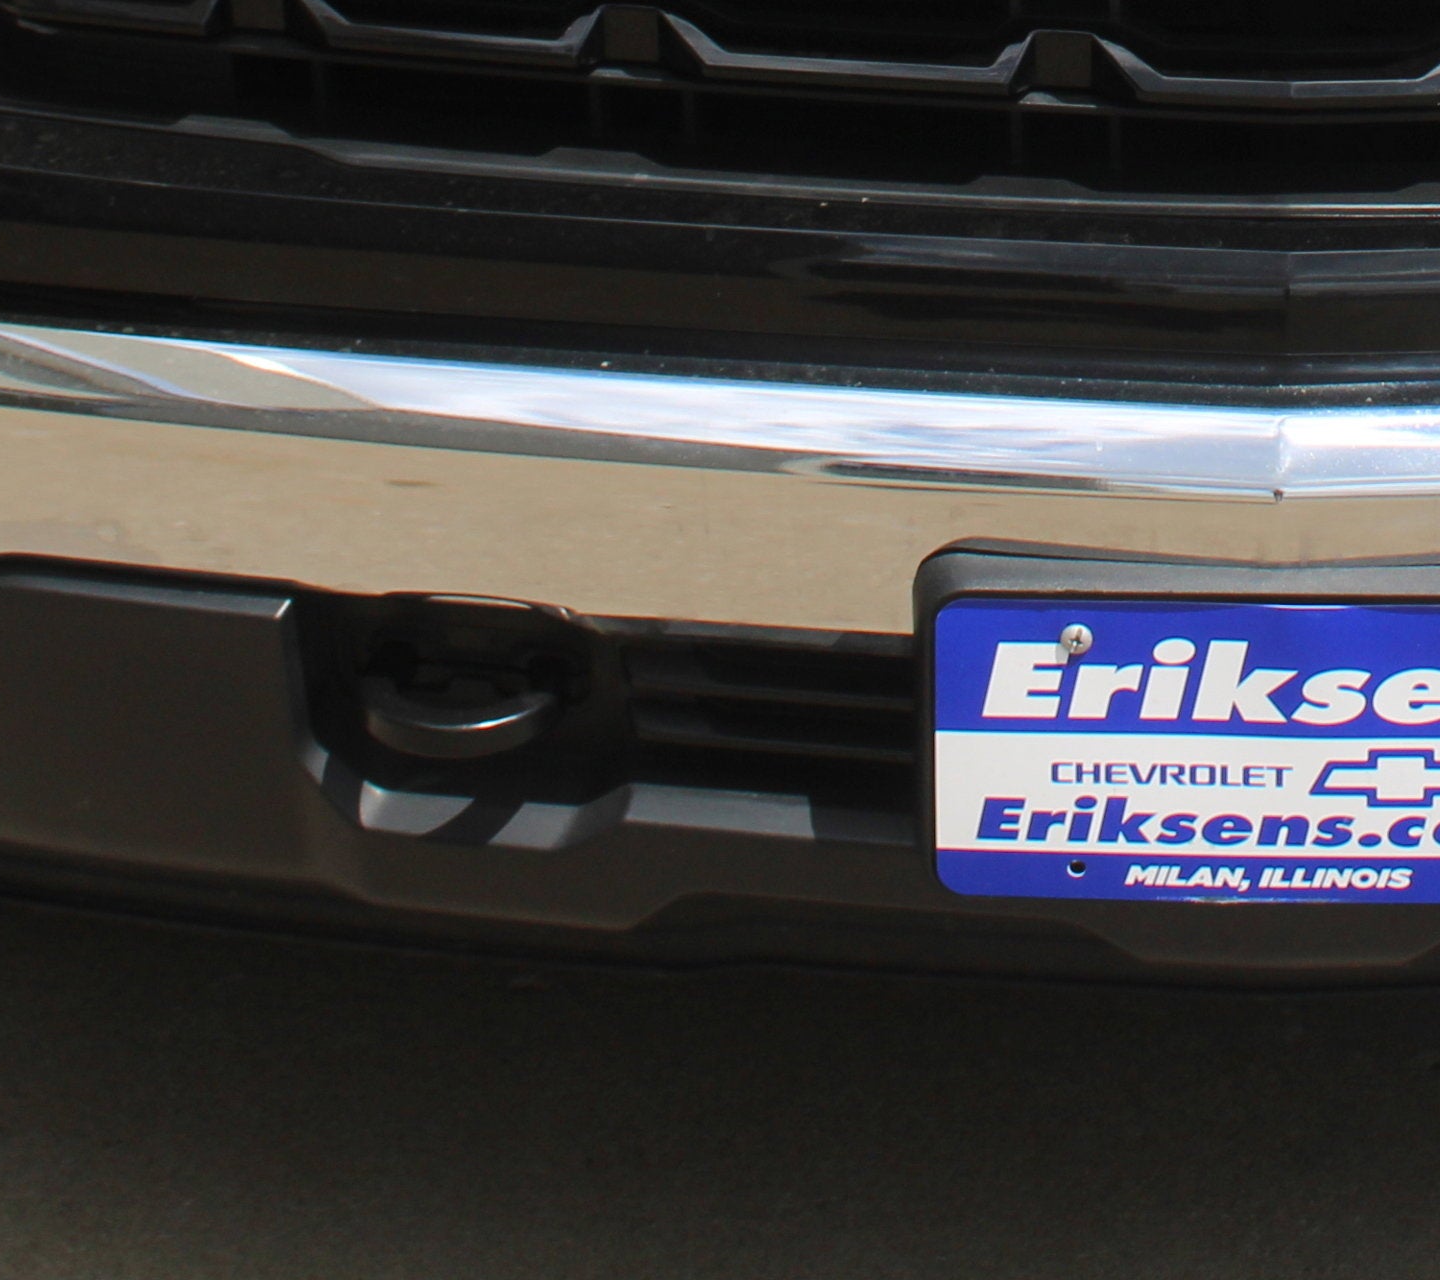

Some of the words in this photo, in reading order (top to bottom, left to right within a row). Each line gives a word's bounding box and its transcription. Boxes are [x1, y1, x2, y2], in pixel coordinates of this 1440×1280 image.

[1050, 762, 1294, 789] CHEVROLET
[1124, 864, 1251, 895] MILAN,
[1259, 868, 1413, 890] ILLINOIS
